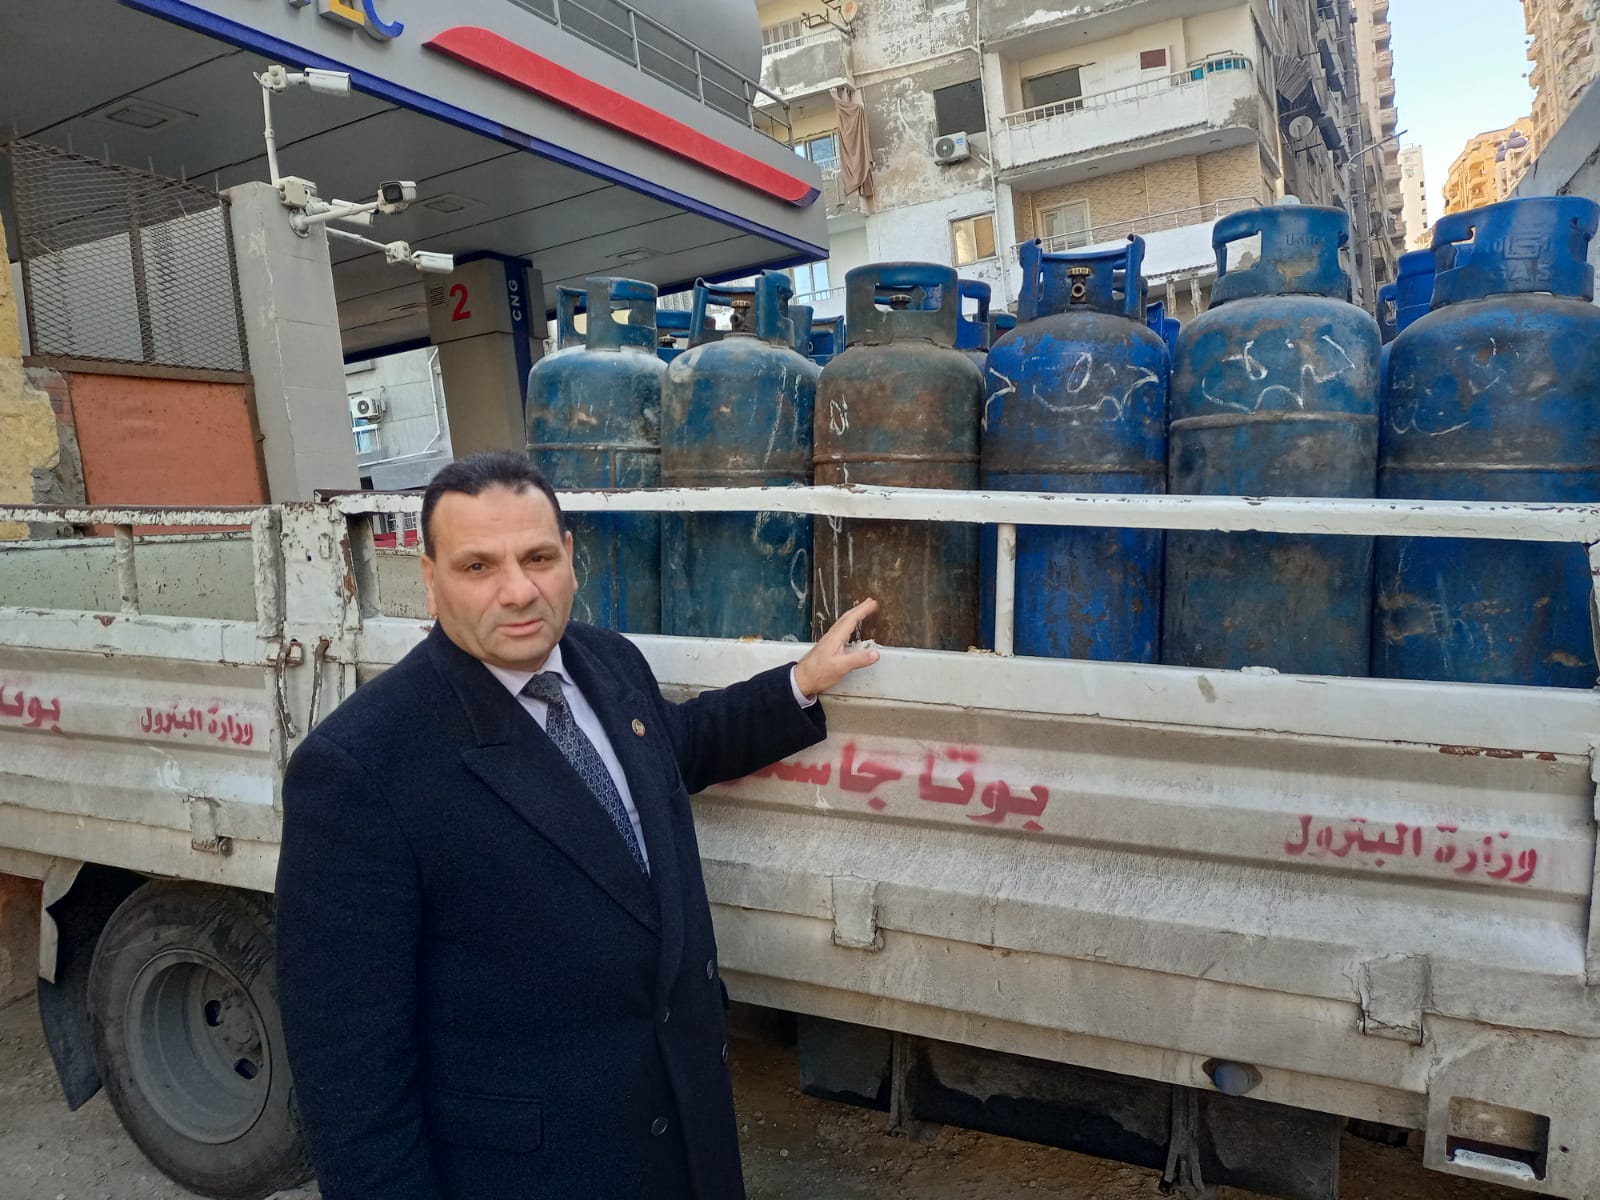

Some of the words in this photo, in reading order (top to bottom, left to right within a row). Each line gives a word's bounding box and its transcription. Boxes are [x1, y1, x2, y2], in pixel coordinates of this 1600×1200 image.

[449, 283, 472, 322] 2
[508, 279, 522, 321] CNG
[139, 703, 203, 738] البترول
[207, 704, 254, 746] وزارة
[1283, 814, 1423, 868] البترول
[1434, 823, 1537, 884] وزارة
